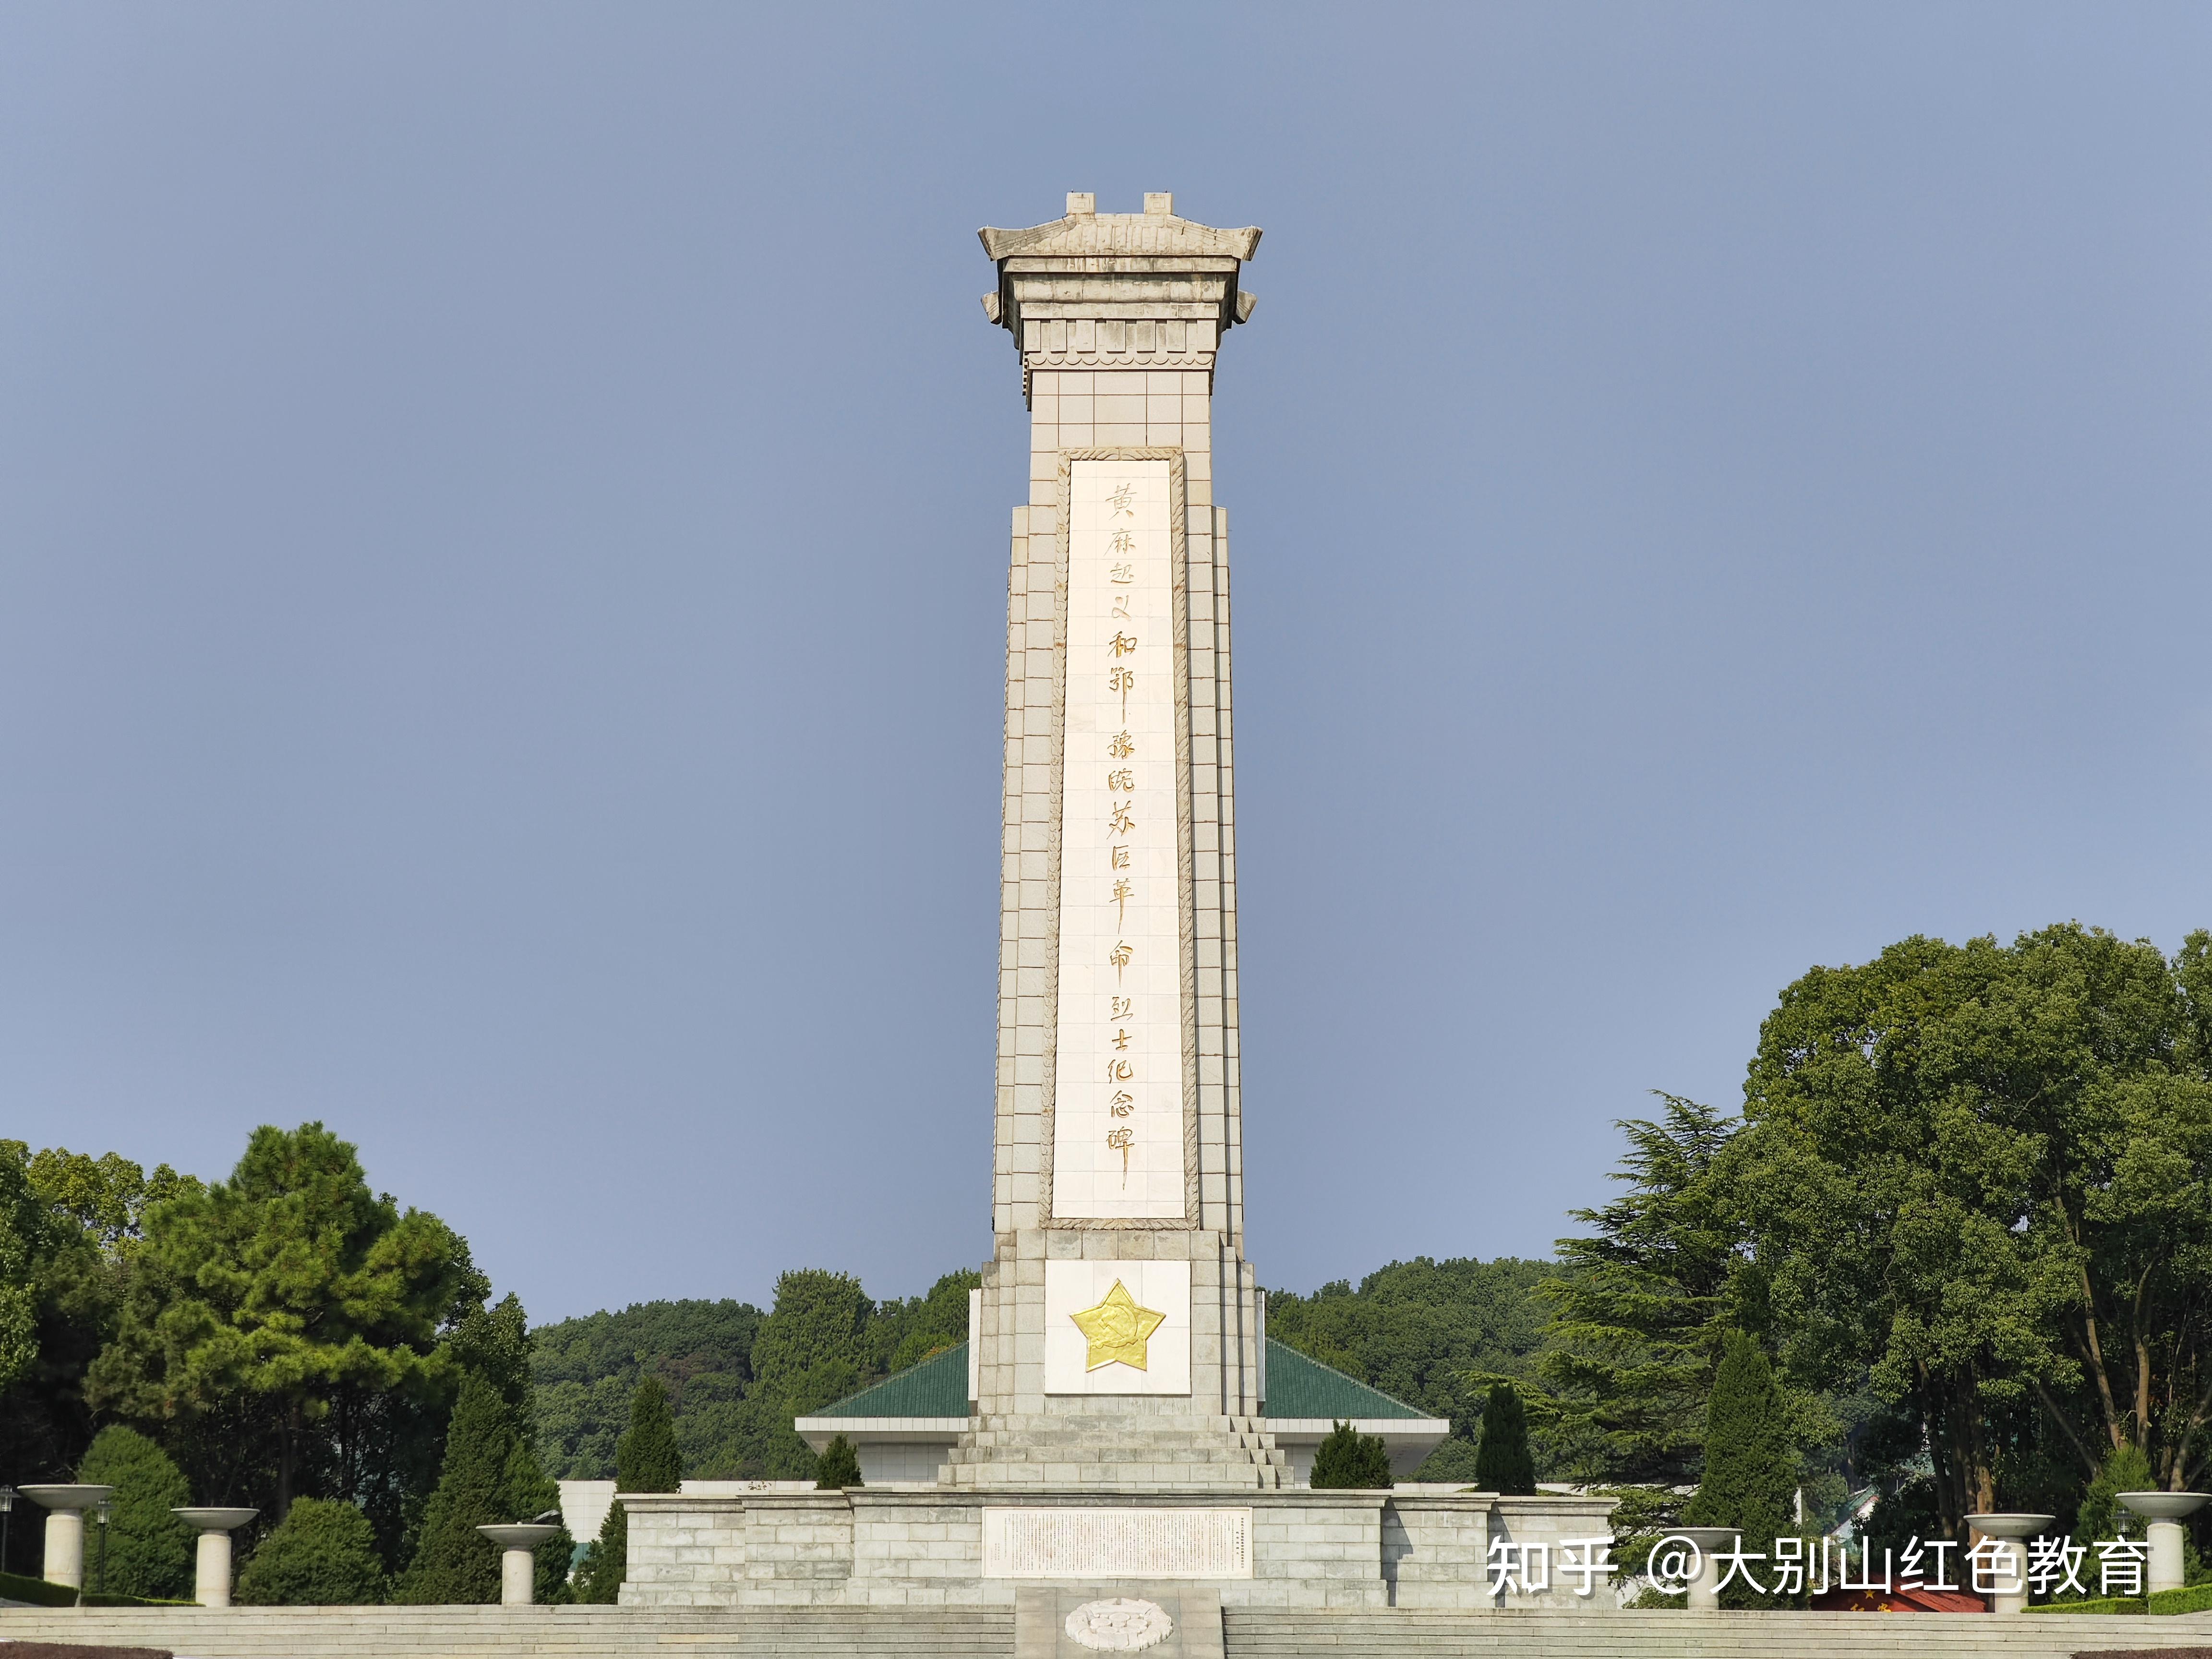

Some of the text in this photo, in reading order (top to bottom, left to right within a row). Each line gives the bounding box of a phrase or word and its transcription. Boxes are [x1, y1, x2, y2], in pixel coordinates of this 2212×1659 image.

[1104, 483, 1138, 1190] 黄麻起义和鄂豫皖苏区革命烈士纪念碑
